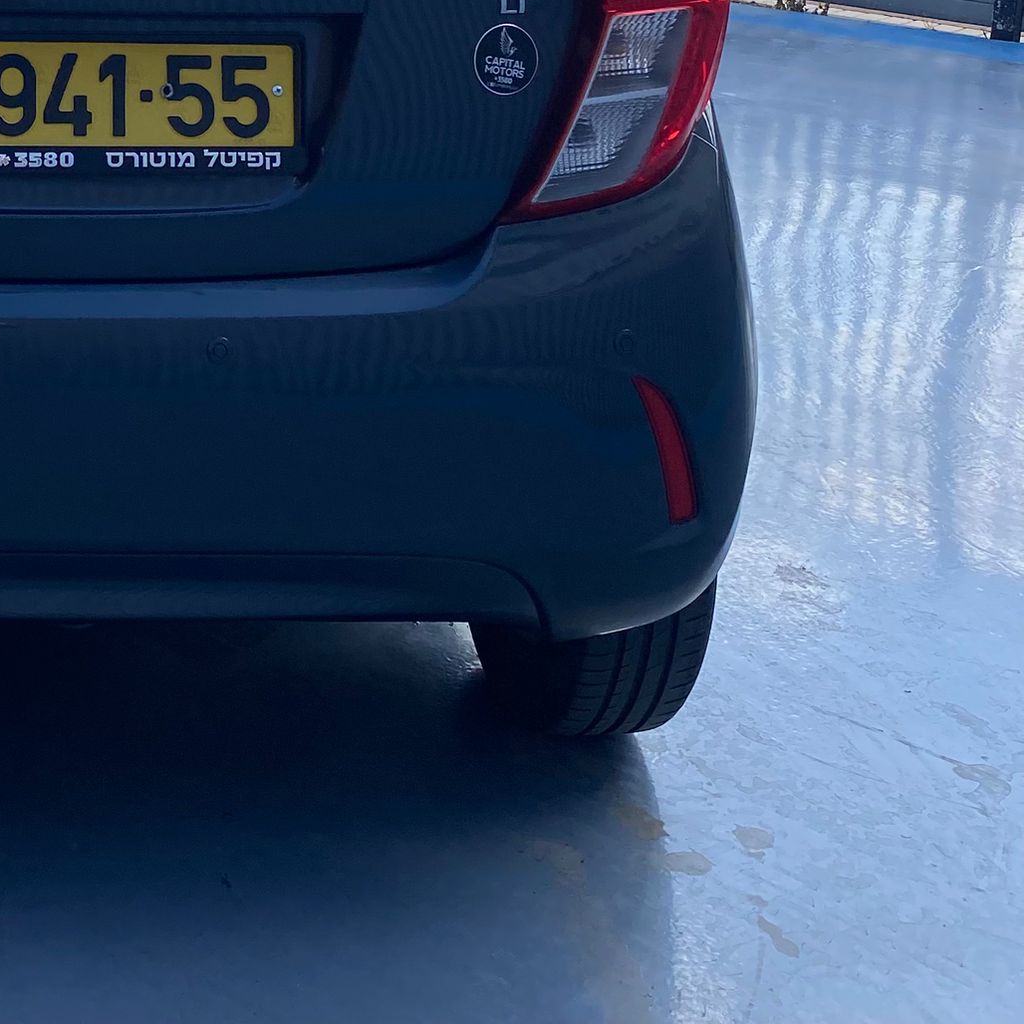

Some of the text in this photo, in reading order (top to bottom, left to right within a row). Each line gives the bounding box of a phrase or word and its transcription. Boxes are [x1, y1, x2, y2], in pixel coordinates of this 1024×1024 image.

[484, 55, 526, 71] CAPITAL
[484, 64, 525, 79] MOTORS
[105, 148, 282, 170] קפיטל מוטורס
